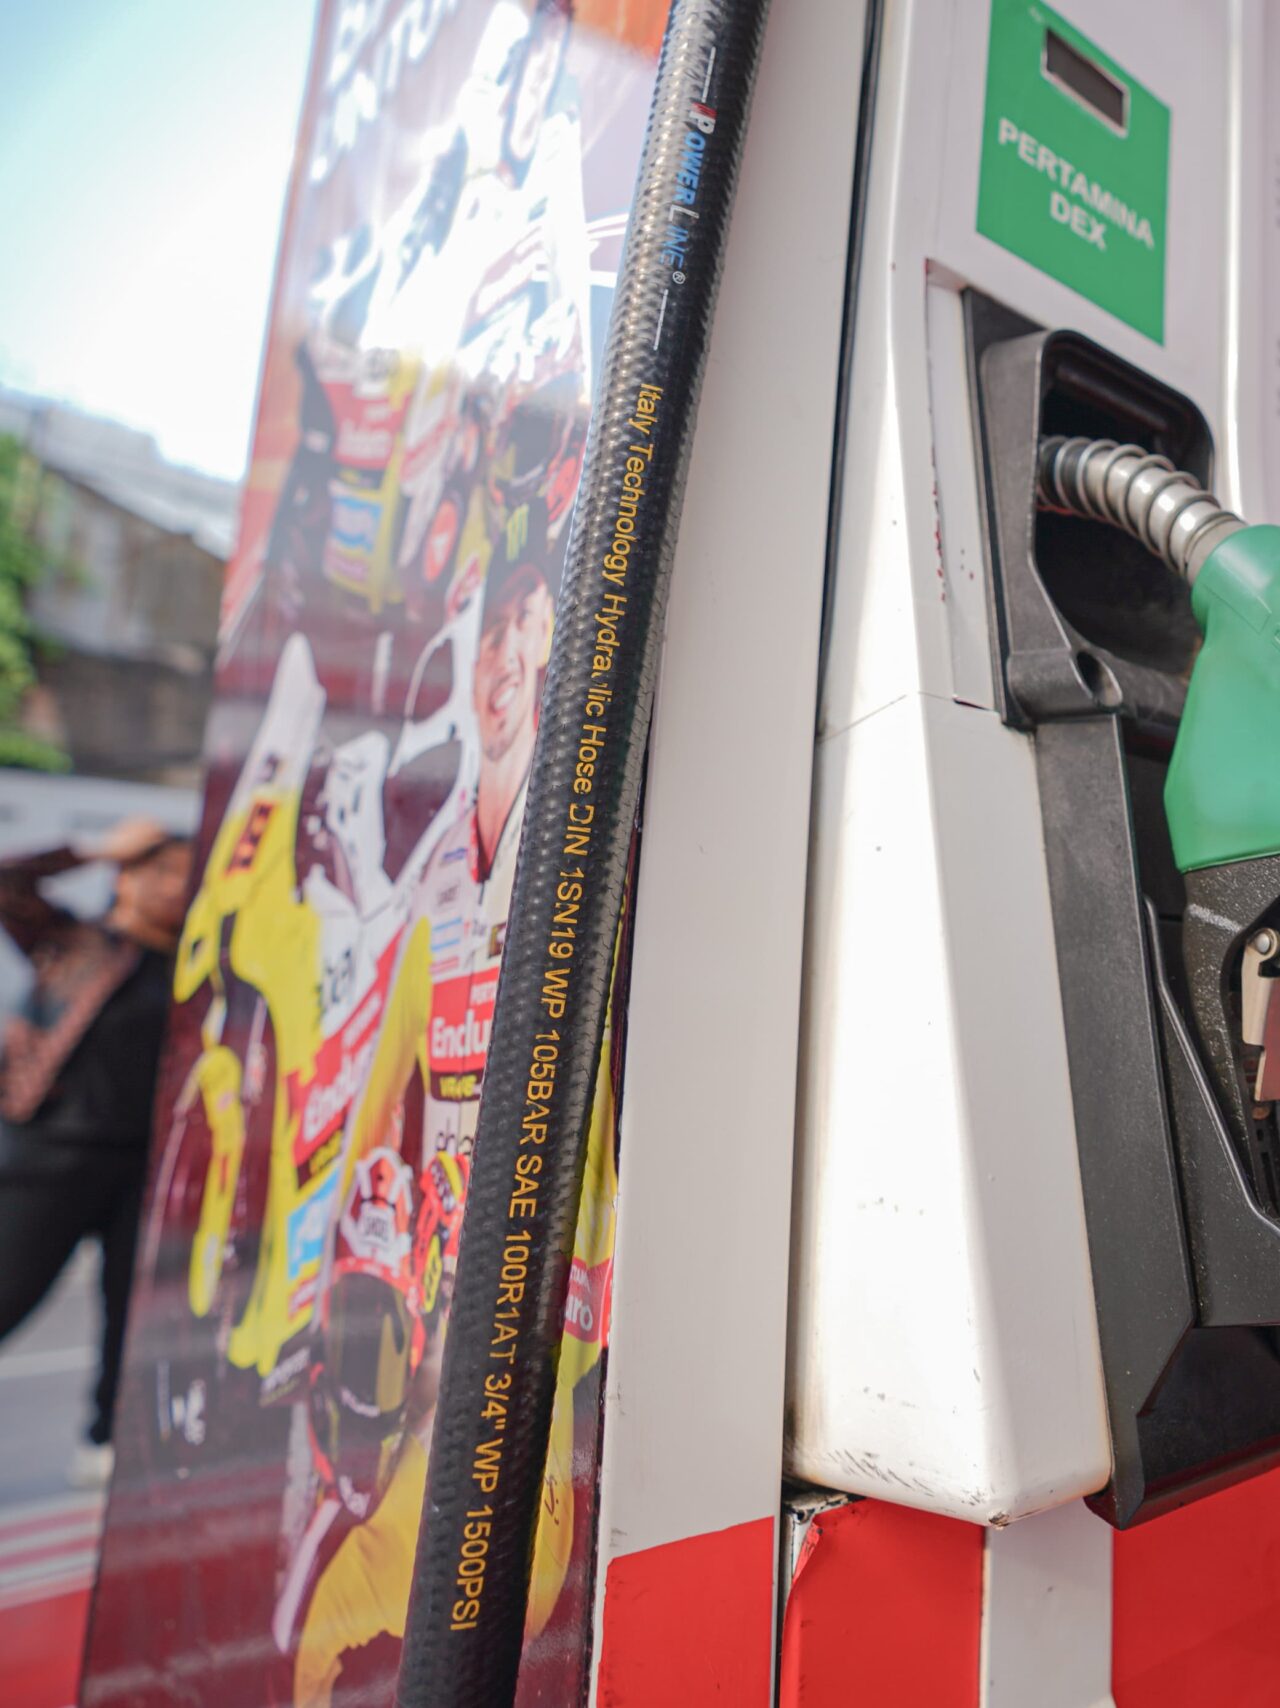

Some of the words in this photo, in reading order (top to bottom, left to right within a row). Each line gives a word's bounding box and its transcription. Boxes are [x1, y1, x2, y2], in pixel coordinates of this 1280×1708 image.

[998, 117, 1154, 249] PERTAMINA
[1050, 191, 1107, 250] DEX
[628, 383, 663, 434] Italy
[602, 444, 653, 586] Technology
[574, 724, 607, 794] Hose
[563, 803, 595, 856] DIN
[547, 867, 585, 959] 1SN19
[540, 967, 571, 1019] WP
[432, 1008, 493, 1058] Endu
[519, 1029, 561, 1145] 105BAR
[509, 1154, 543, 1218] SAE
[471, 1438, 504, 1493] WP
[450, 1504, 494, 1631] 1500PSI
